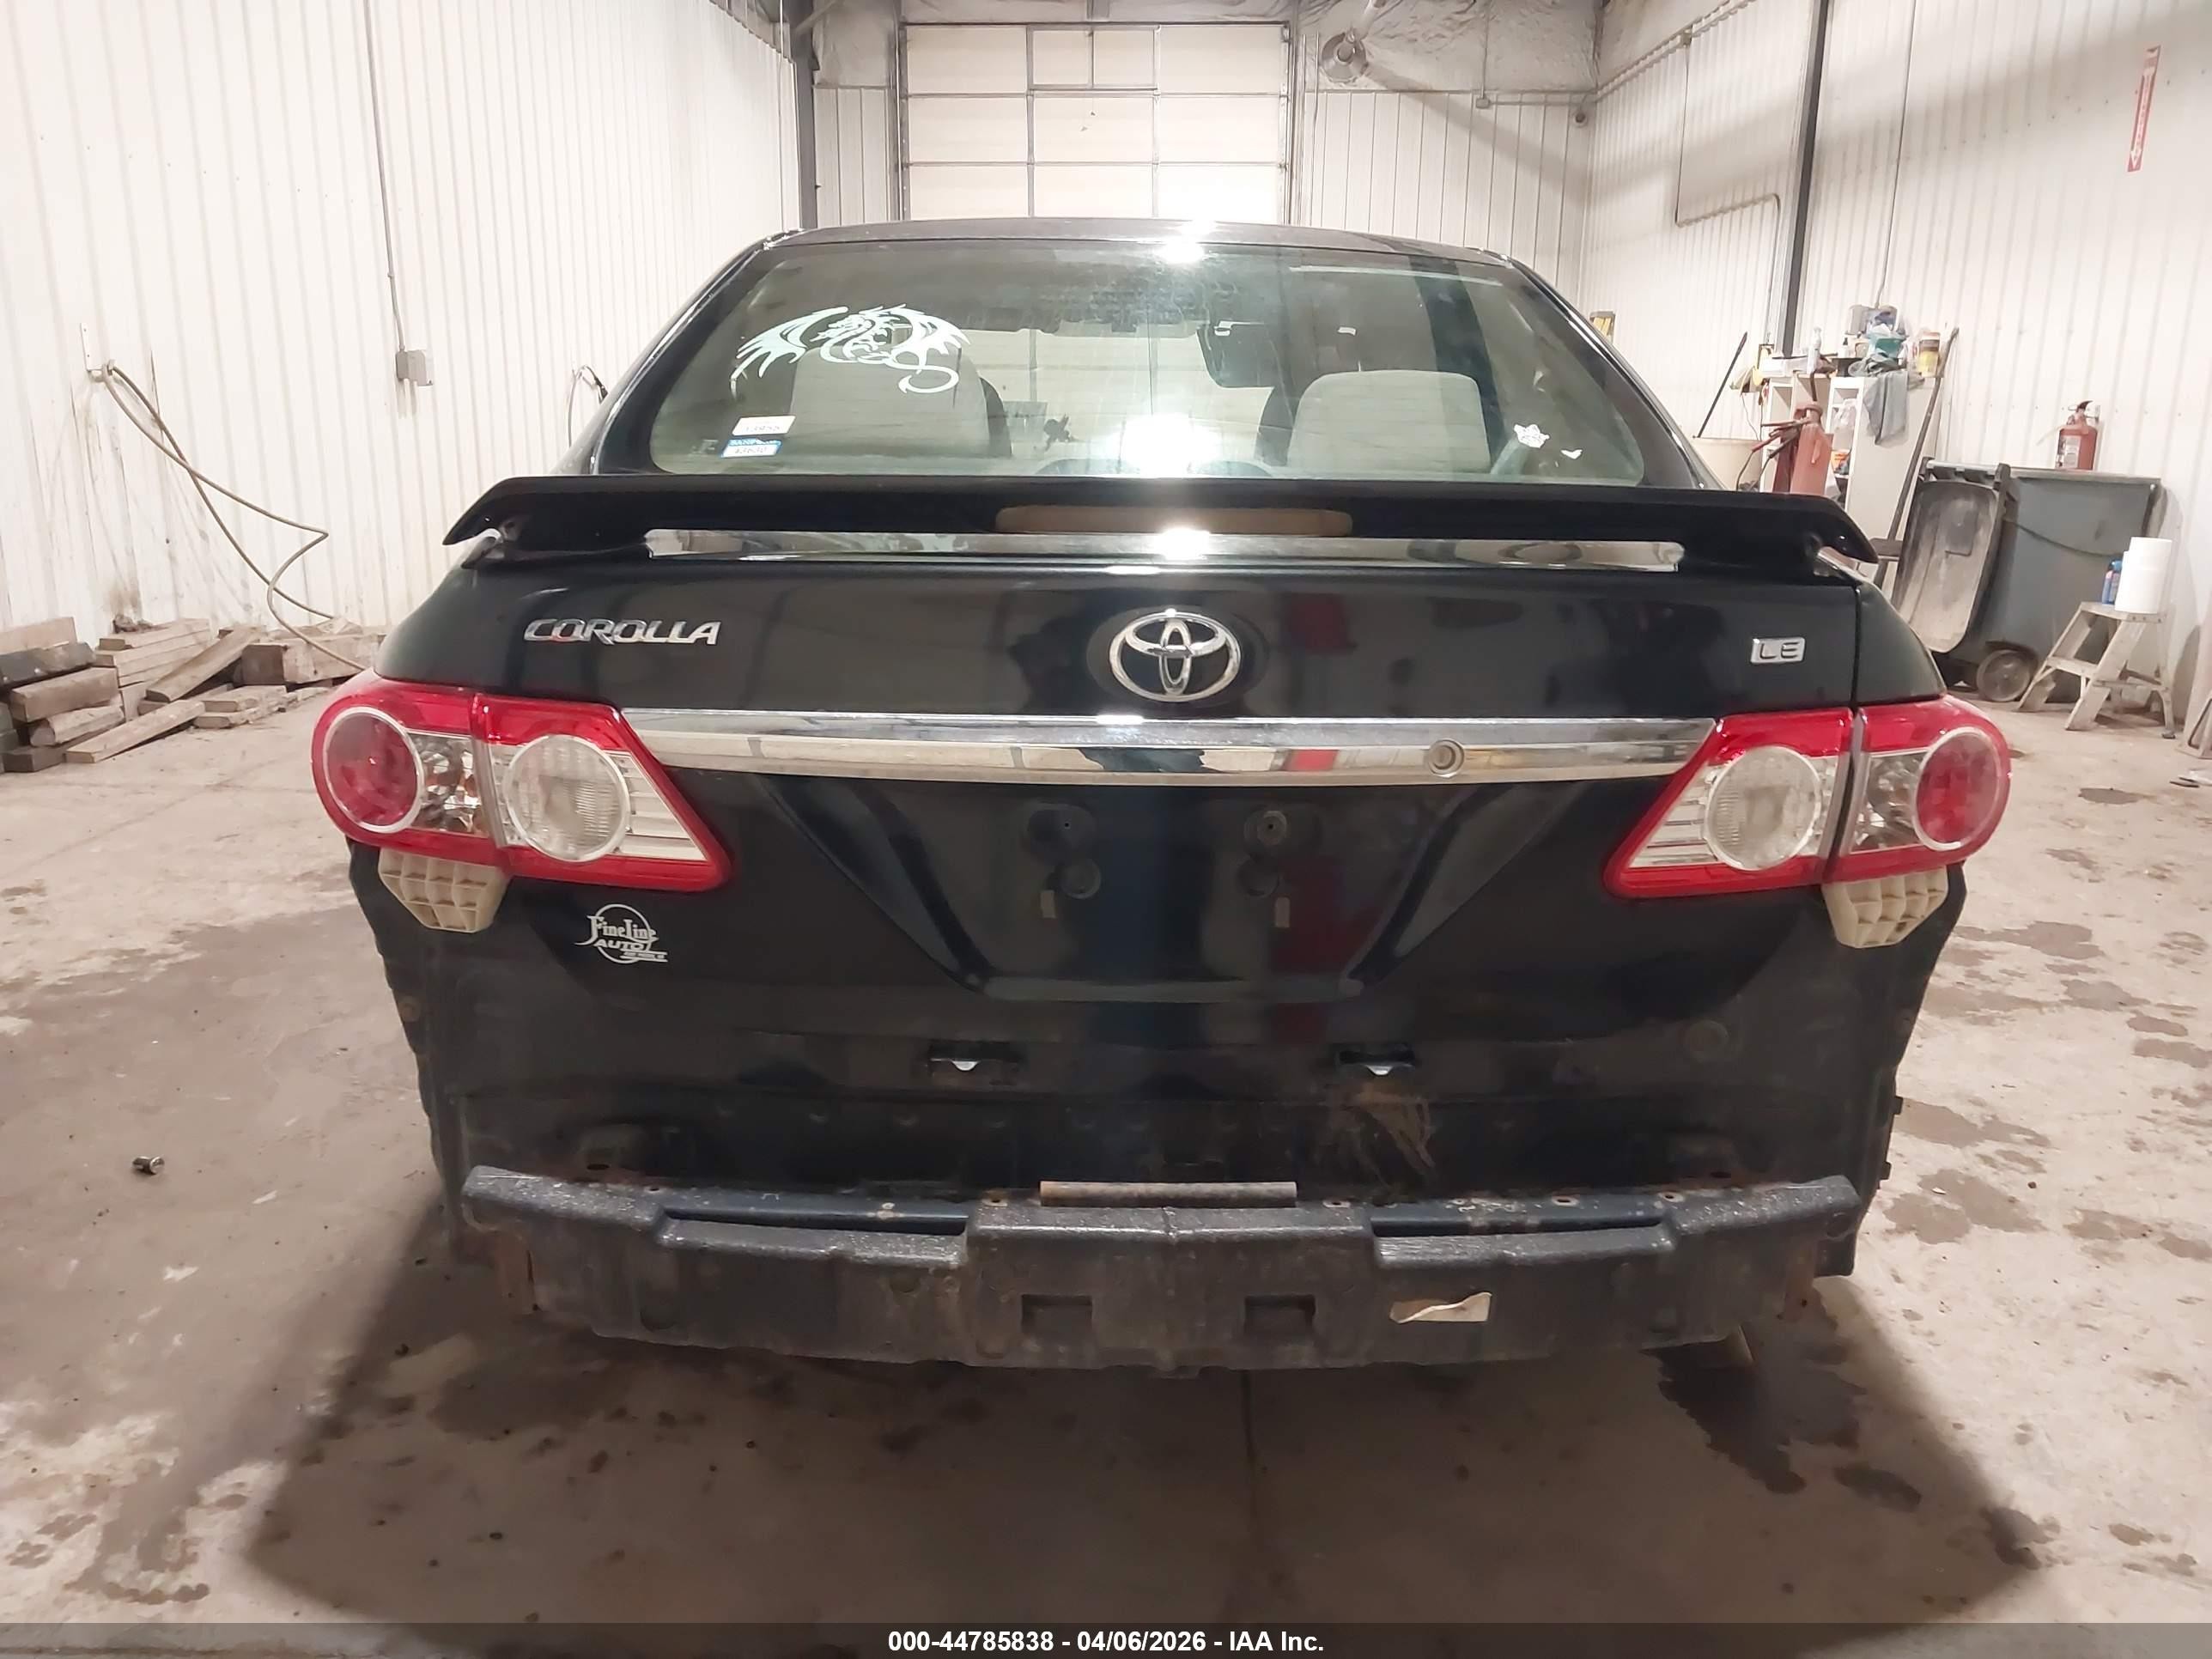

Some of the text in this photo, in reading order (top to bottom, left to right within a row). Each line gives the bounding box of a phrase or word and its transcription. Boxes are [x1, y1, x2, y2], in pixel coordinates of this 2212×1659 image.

[524, 618, 722, 645] COROLLA
[1757, 640, 1801, 661] LE
[592, 939, 645, 951] AUTO
